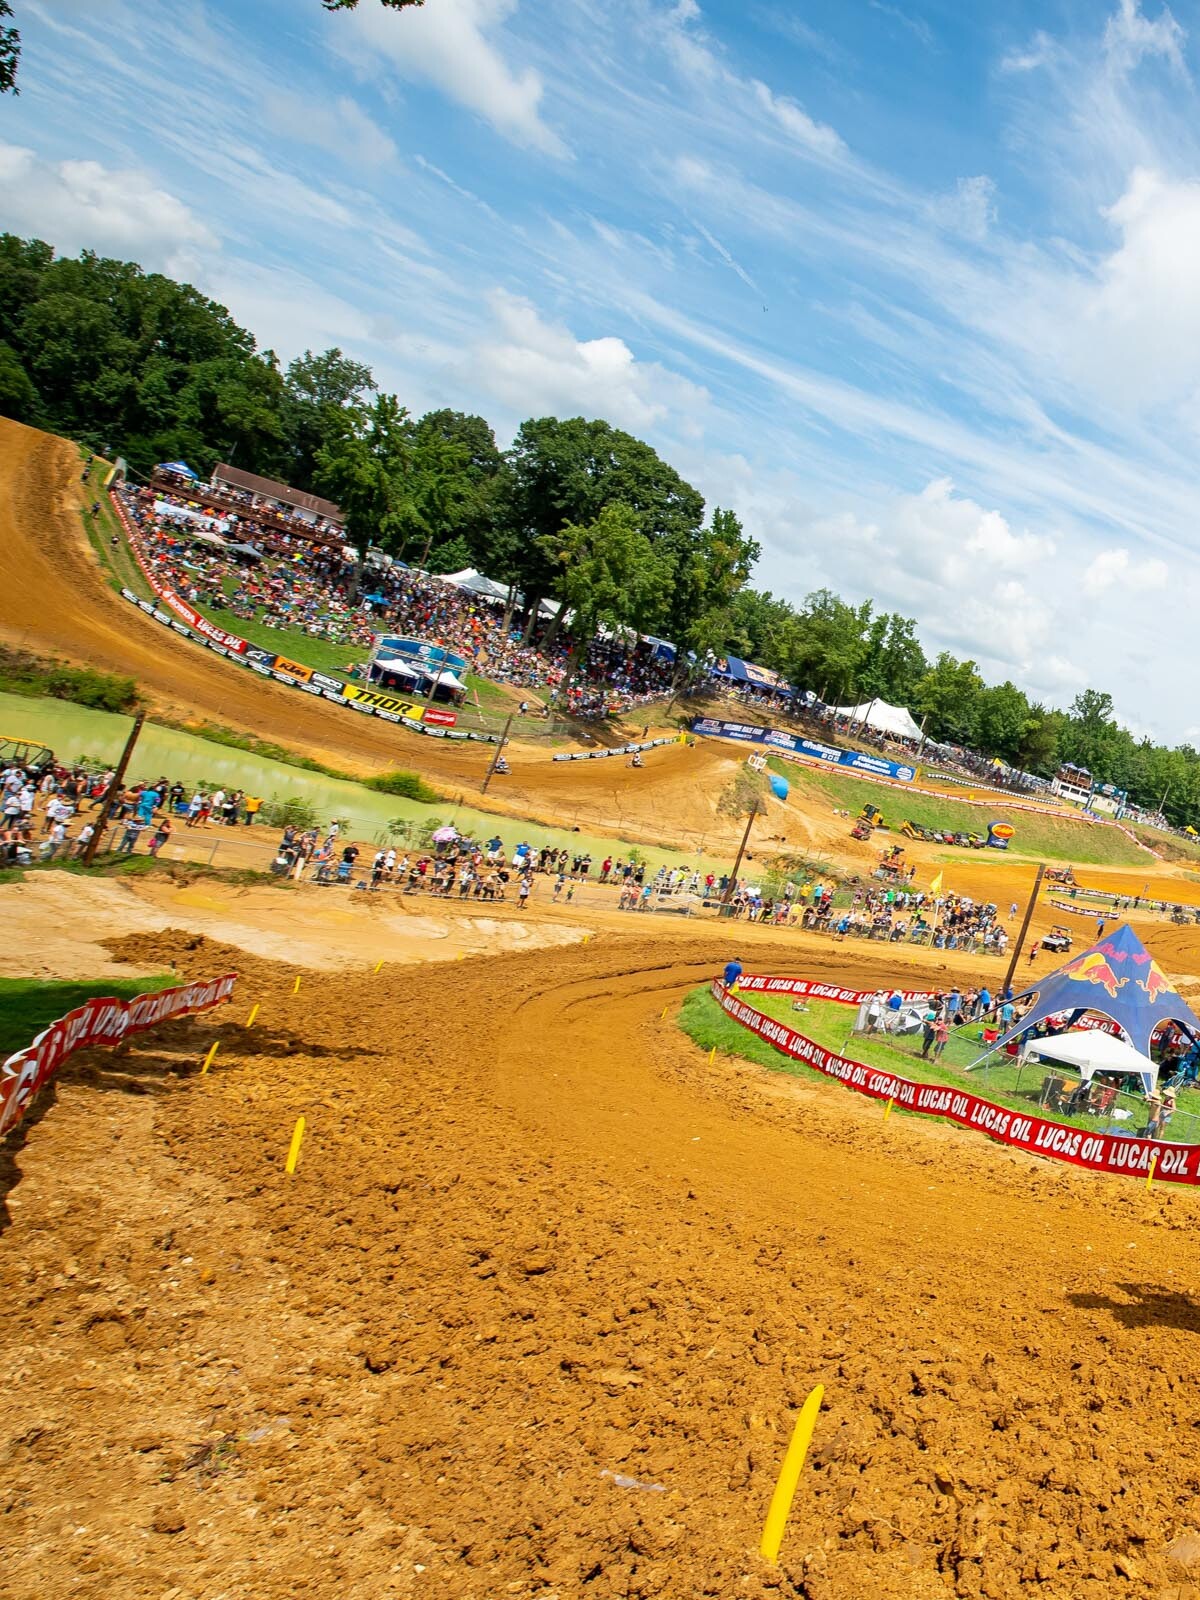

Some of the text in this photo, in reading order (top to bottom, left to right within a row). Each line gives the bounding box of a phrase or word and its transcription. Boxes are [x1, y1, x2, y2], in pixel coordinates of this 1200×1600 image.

[223, 635, 242, 650] OIL
[279, 663, 307, 677] KTM
[352, 689, 414, 715] THOR
[751, 977, 767, 989] OIL
[766, 979, 794, 991] LUCAS
[792, 981, 809, 993] OIL
[808, 983, 840, 998] LUCAS
[839, 990, 855, 1002] OIL
[788, 1035, 815, 1060] LUCAS
[812, 1048, 826, 1068] OIL
[825, 1056, 854, 1080] LUCAS
[851, 1066, 869, 1086] OIL
[868, 1073, 901, 1099] LUCAS
[899, 1083, 916, 1104] OIL
[917, 1088, 952, 1111] LUCAS
[951, 1094, 969, 1118] OIL
[970, 1103, 1011, 1135] LUCAS
[1009, 1117, 1033, 1142] OIL
[1034, 1125, 1082, 1157] LUCAS
[1080, 1137, 1105, 1163] OIL
[1108, 1142, 1160, 1170] LUCAS
[1160, 1148, 1189, 1175] OIL
